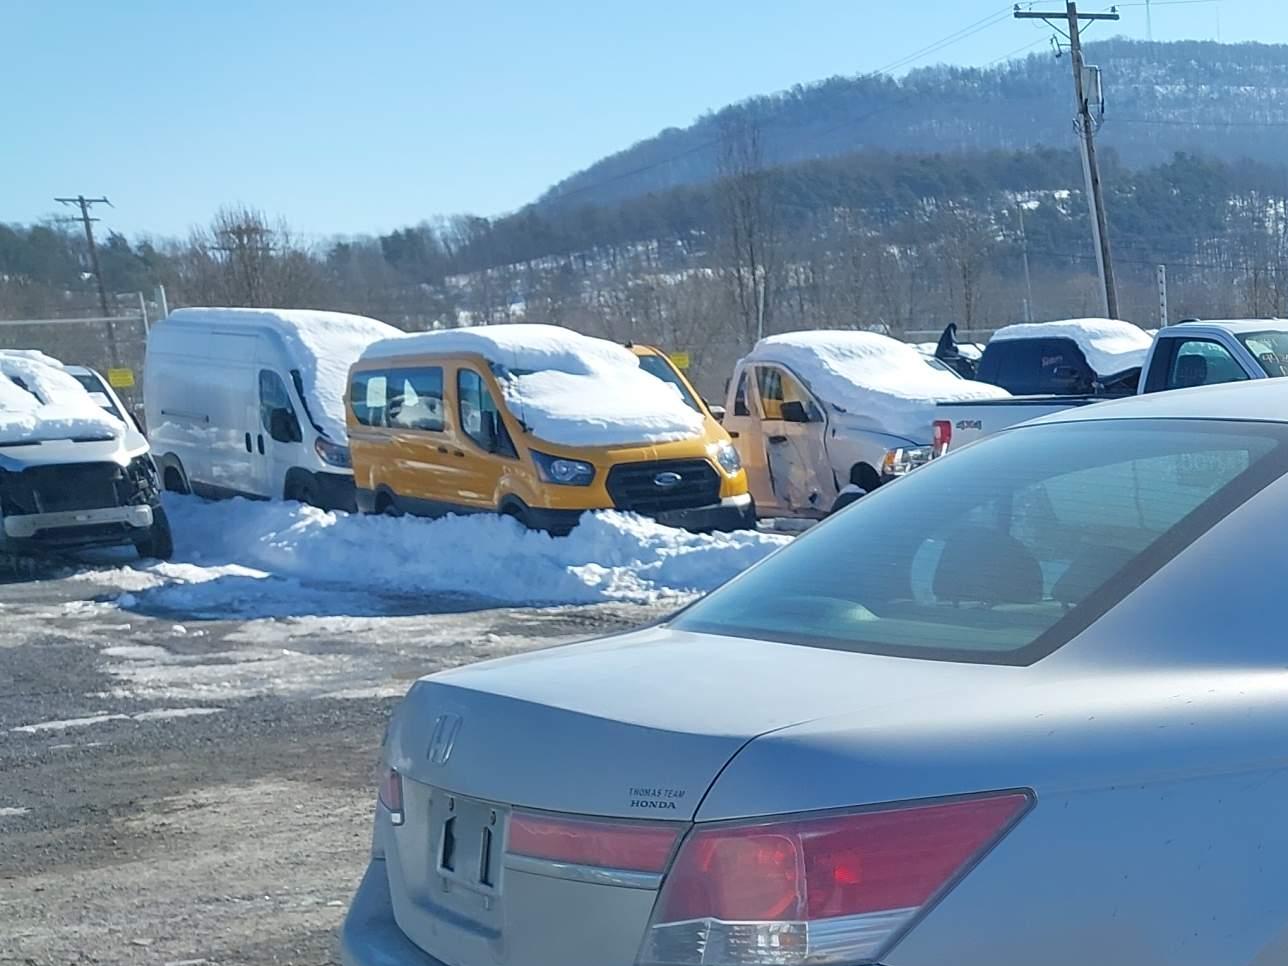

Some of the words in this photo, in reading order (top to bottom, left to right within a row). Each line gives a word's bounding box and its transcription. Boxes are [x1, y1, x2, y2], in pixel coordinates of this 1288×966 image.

[629, 788, 661, 798] THOMAS
[664, 789, 686, 799] TEAM
[630, 800, 676, 809] HONDA
